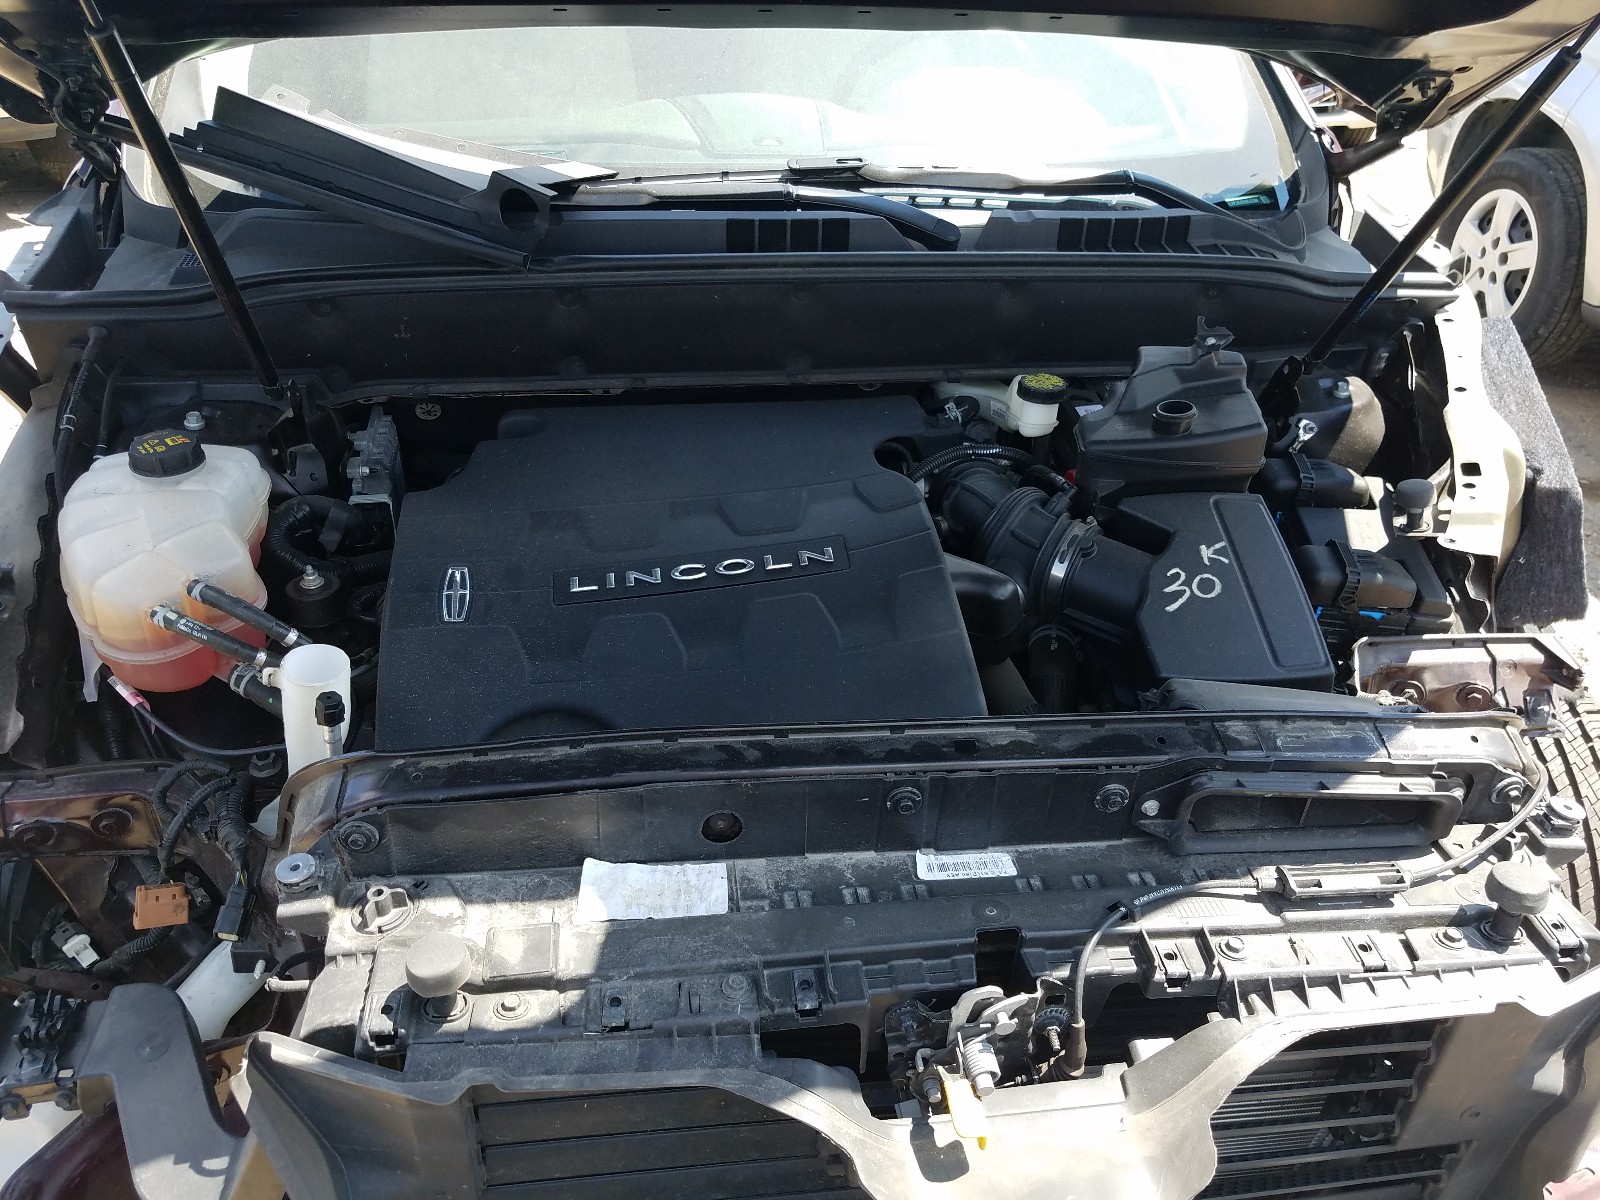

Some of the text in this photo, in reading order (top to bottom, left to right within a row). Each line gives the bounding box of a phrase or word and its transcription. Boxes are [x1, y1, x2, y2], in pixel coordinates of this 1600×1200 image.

[569, 546, 834, 593] LINCOLN
[1162, 541, 1230, 612] 30 K
